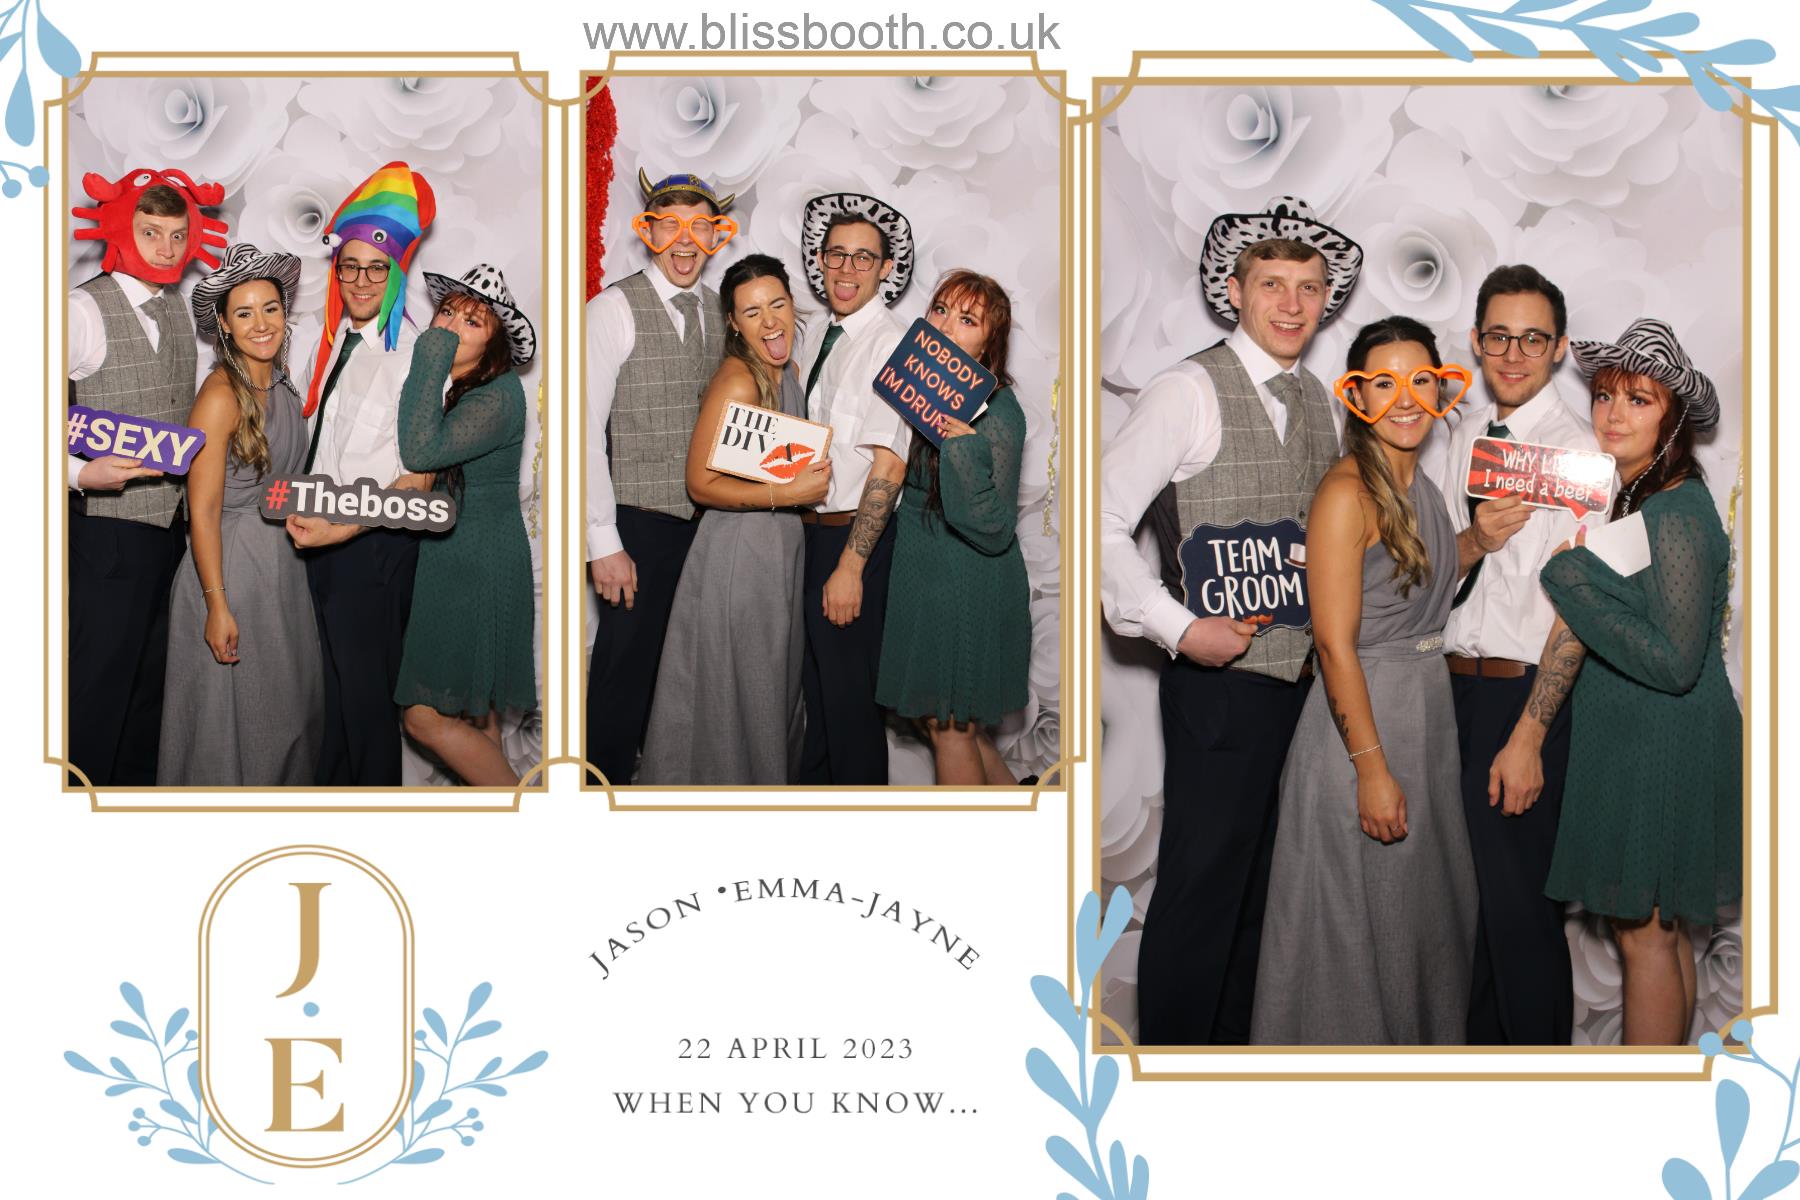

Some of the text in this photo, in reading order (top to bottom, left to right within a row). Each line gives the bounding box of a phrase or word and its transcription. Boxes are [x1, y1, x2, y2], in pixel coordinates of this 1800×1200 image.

[904, 354, 965, 410] KNOWS
[914, 330, 984, 391] NOBODY
[730, 405, 779, 434] THE
[879, 366, 948, 438] I'M DRUN
[68, 413, 198, 467] #SEXY
[1502, 449, 1537, 473] WHY
[265, 479, 449, 523] #Theboss
[1483, 468, 1492, 488] I
[1496, 472, 1536, 493] need
[1540, 481, 1549, 497] a
[1207, 536, 1282, 577] TEAM
[1201, 571, 1304, 619] GROOM
